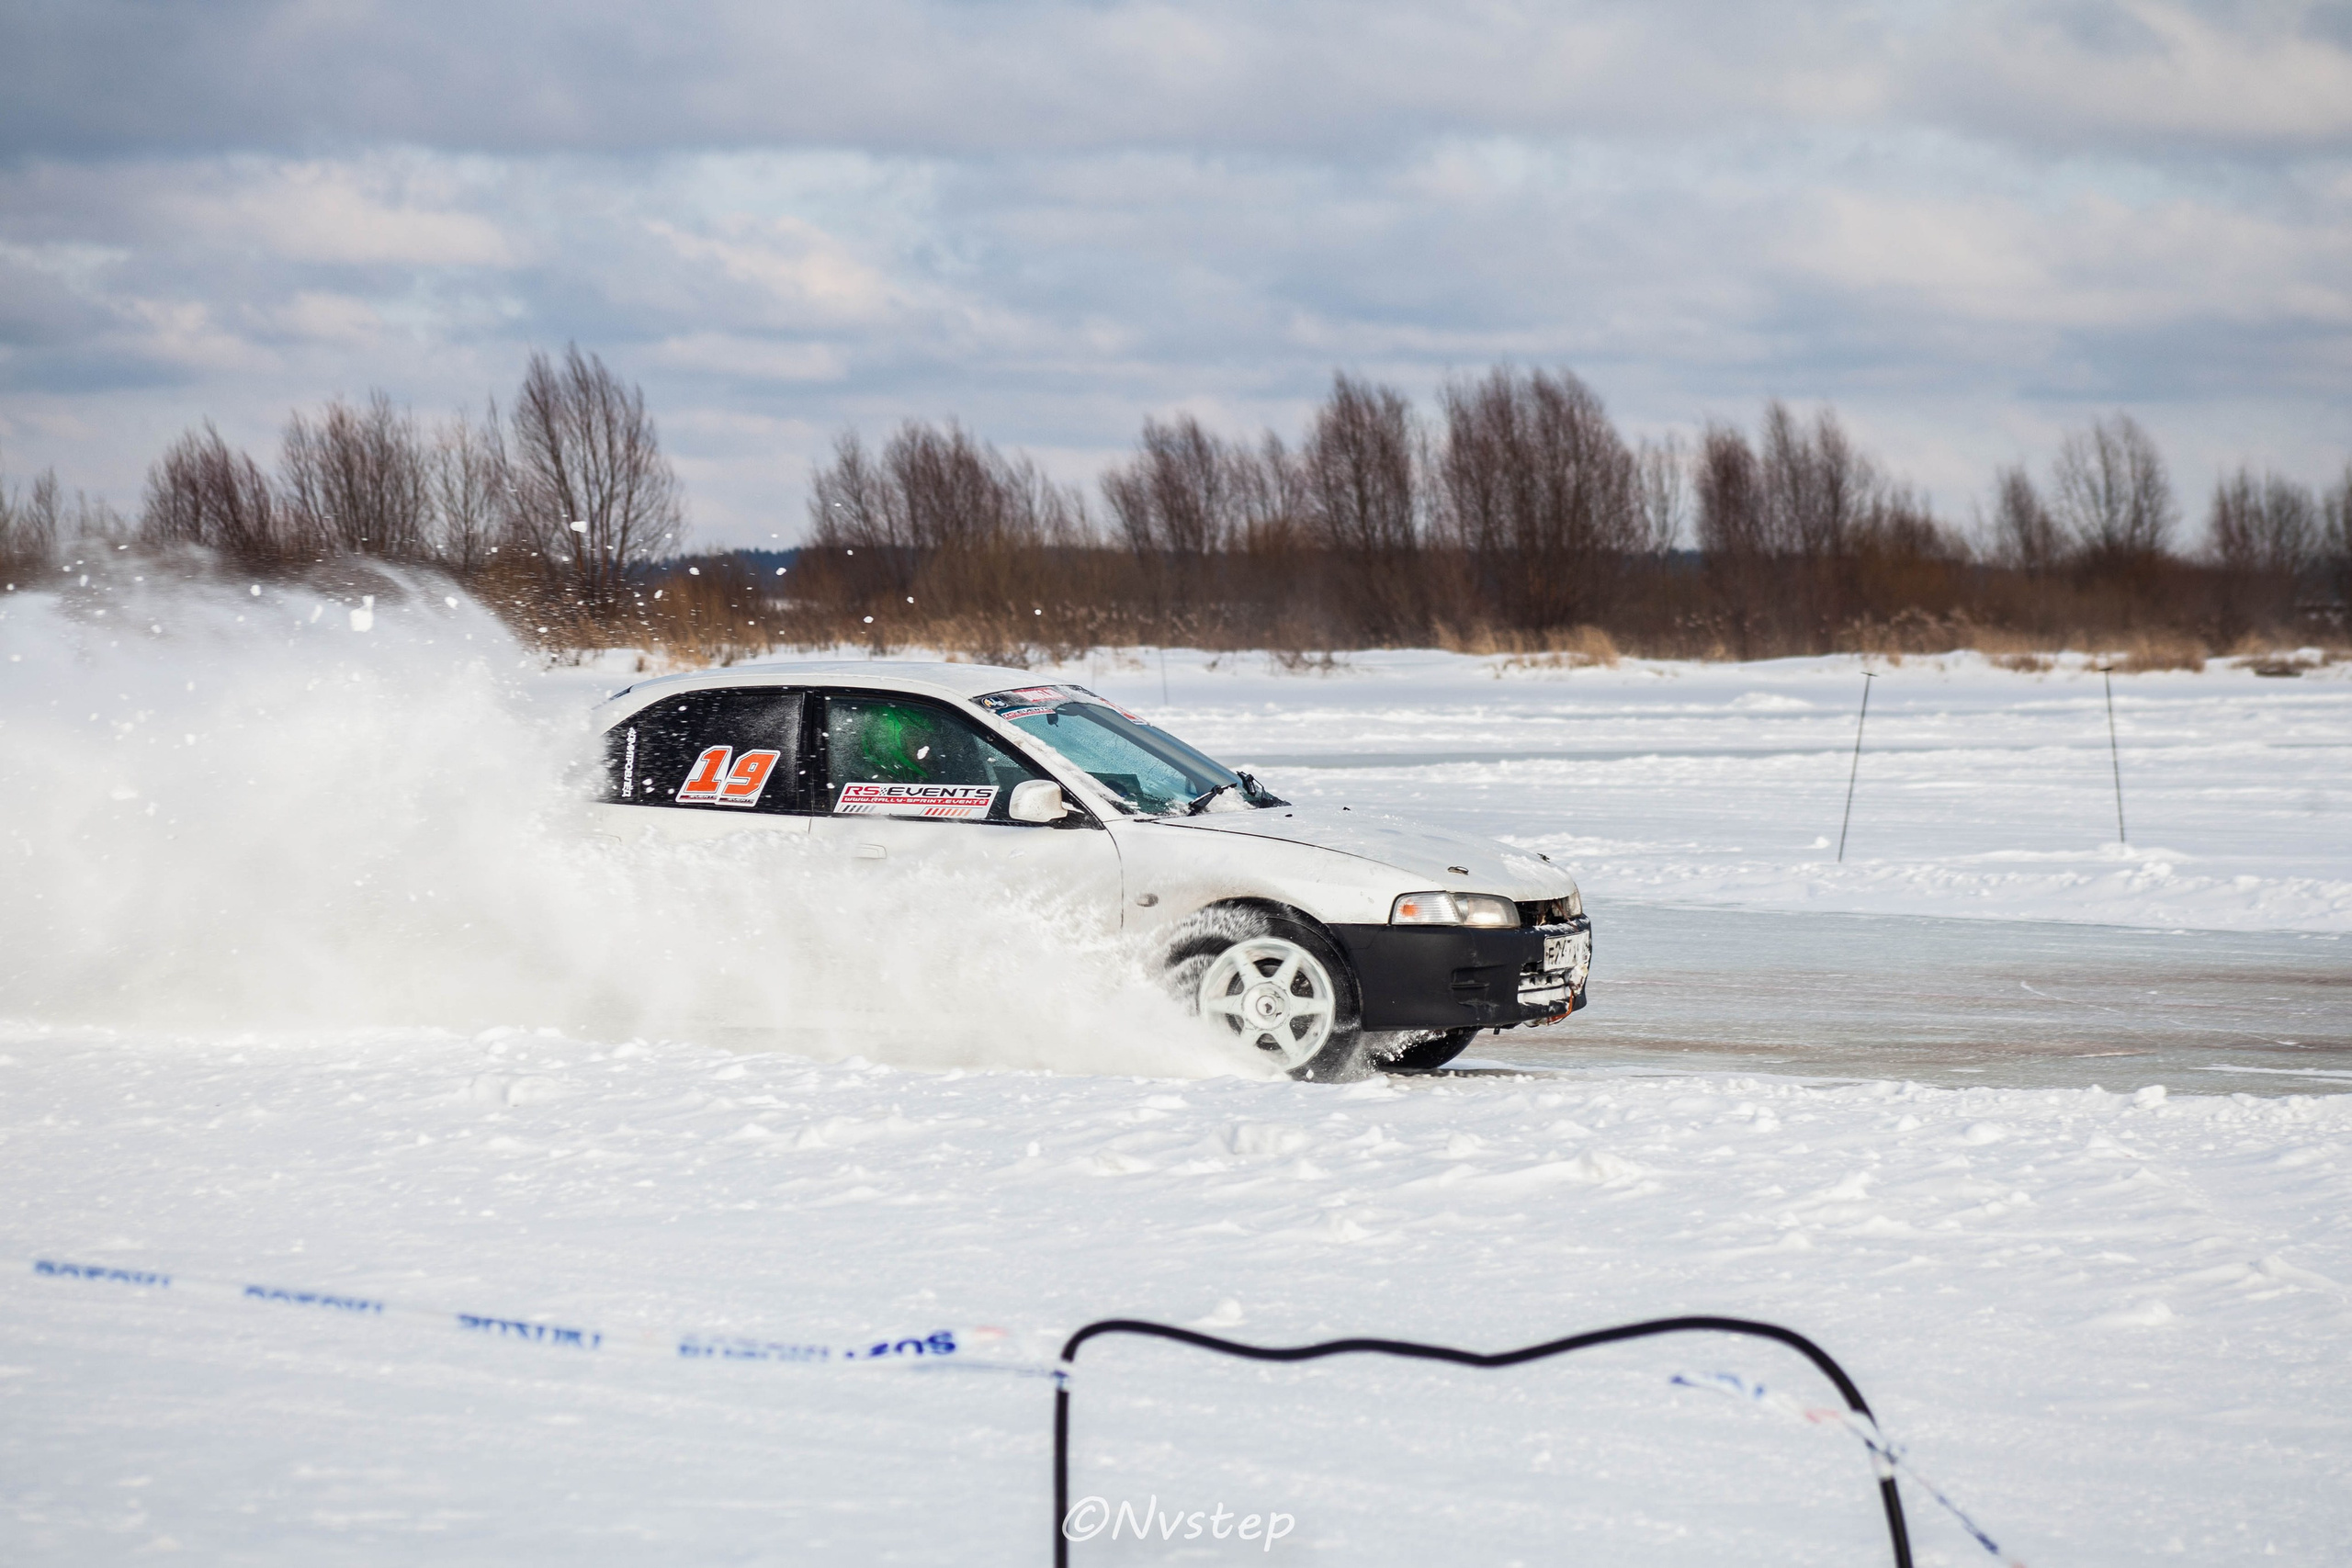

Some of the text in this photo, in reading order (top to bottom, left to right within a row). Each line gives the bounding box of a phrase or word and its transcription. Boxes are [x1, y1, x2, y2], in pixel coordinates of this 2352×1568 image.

[684, 748, 778, 798] 19
[887, 787, 993, 798] EVENTS
[843, 796, 988, 805] WWW.RALLY-SPRINT.EVENTS
